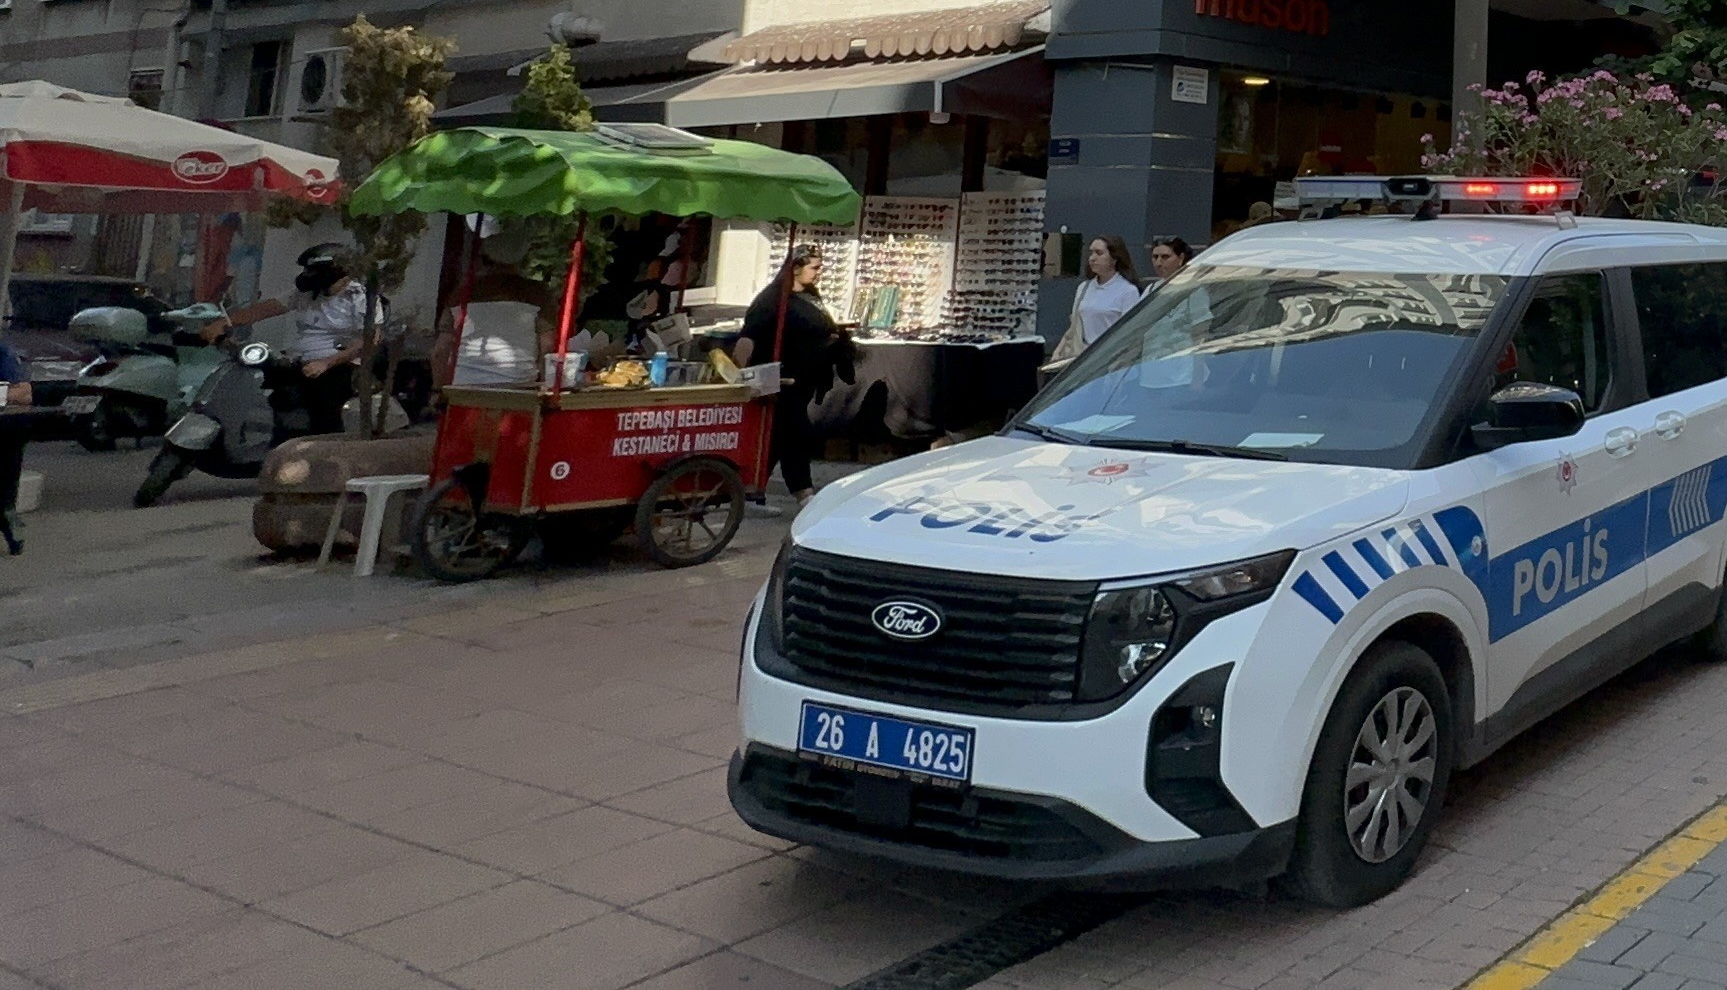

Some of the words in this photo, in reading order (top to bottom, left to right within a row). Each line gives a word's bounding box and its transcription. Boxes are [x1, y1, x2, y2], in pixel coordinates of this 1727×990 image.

[617, 410, 675, 433] TEPEBAŞI
[612, 430, 680, 457] KESTANECİ
[682, 435, 691, 451] &
[555, 465, 566, 477] 6
[1513, 518, 1608, 617] POLİS
[882, 606, 927, 634] Ford
[815, 712, 845, 751] 26
[865, 721, 879, 759] A
[903, 728, 966, 773] 4825
